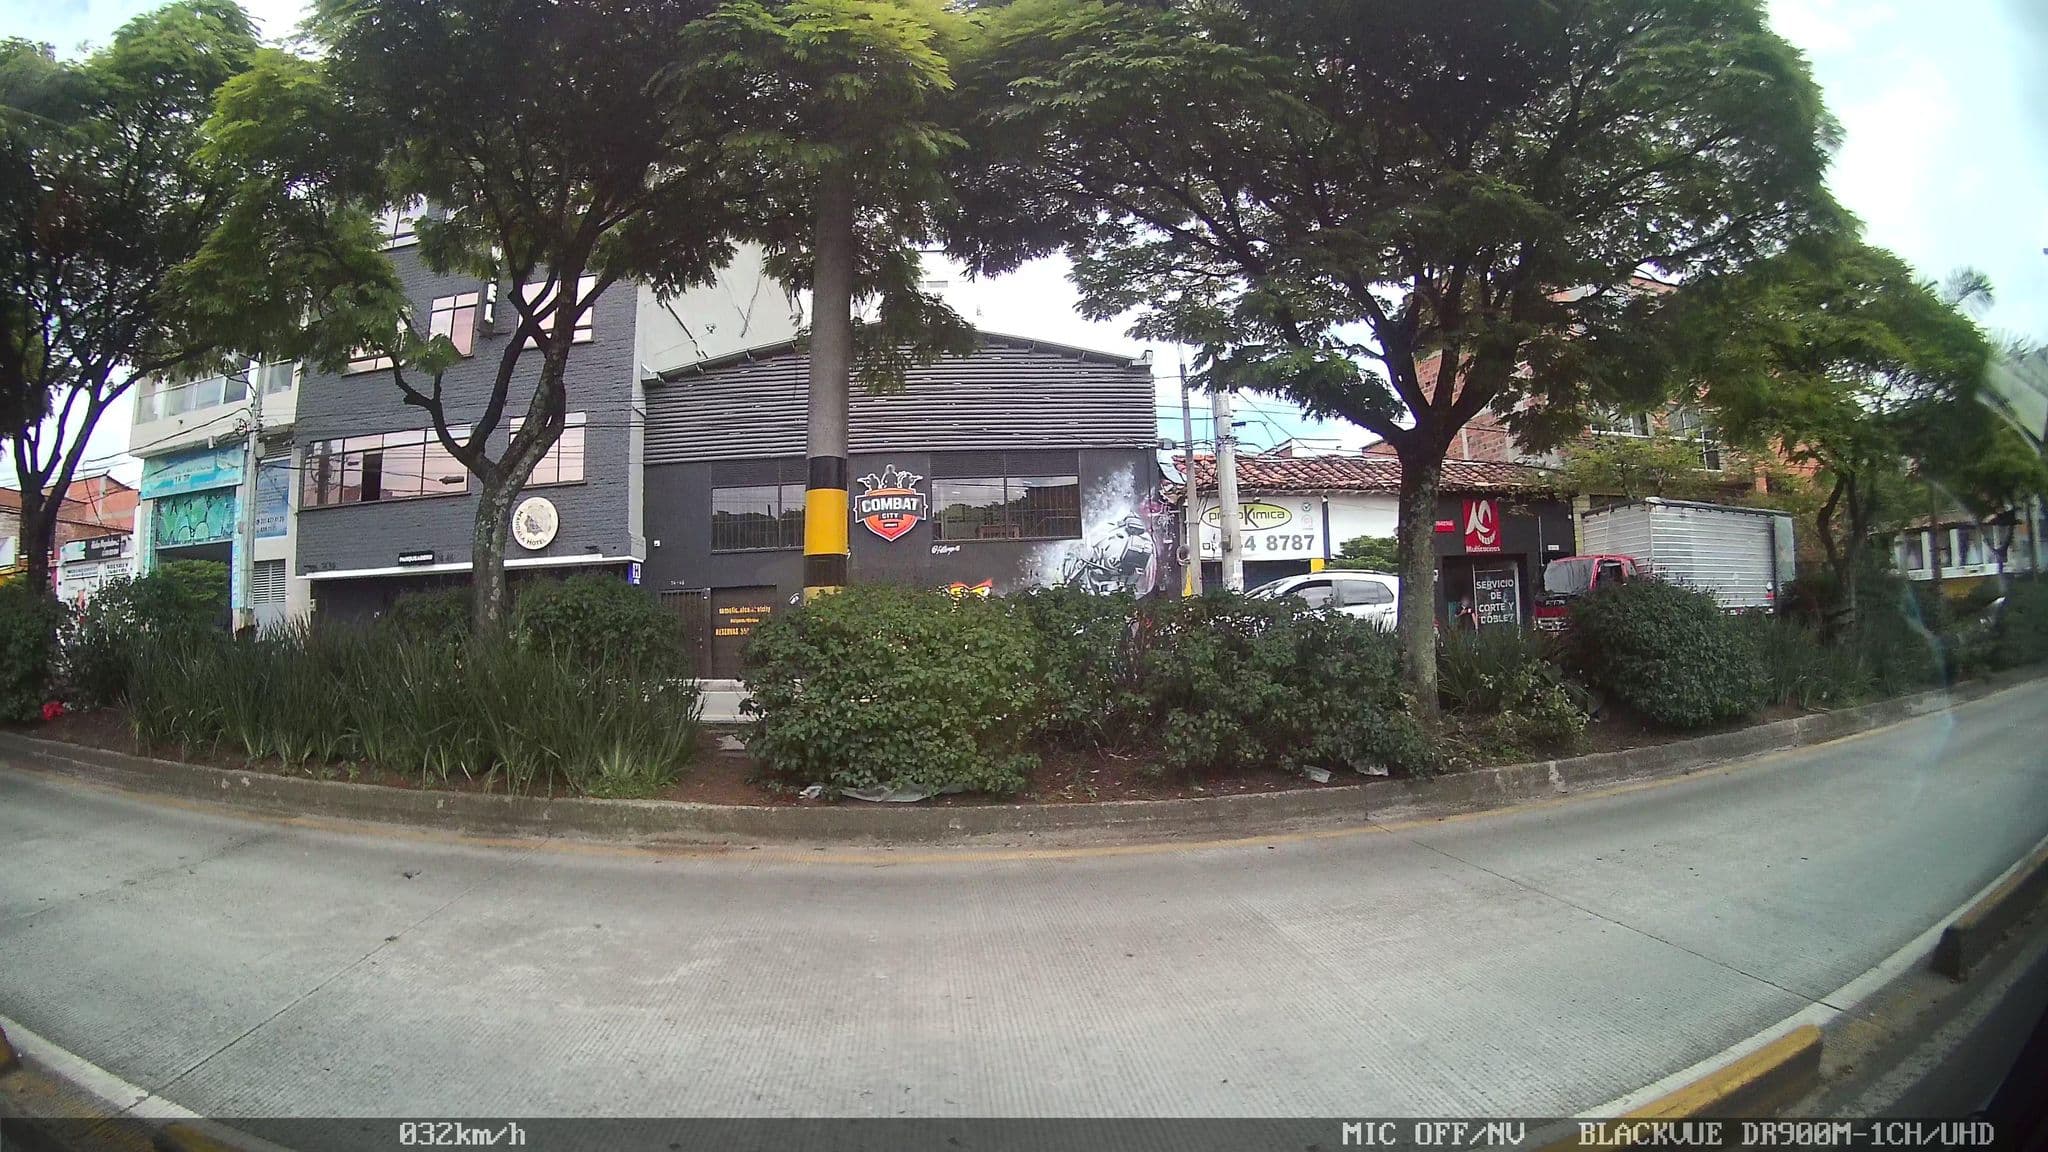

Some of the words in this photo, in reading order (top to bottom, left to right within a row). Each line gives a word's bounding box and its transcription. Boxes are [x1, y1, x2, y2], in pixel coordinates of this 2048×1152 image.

[861, 497, 918, 513] COMBAT
[1266, 534, 1315, 551] 8787
[1476, 579, 1514, 590] SERVICIO
[1490, 591, 1502, 600] DE
[1479, 602, 1506, 612] CORTE
[1508, 602, 1514, 610] Y
